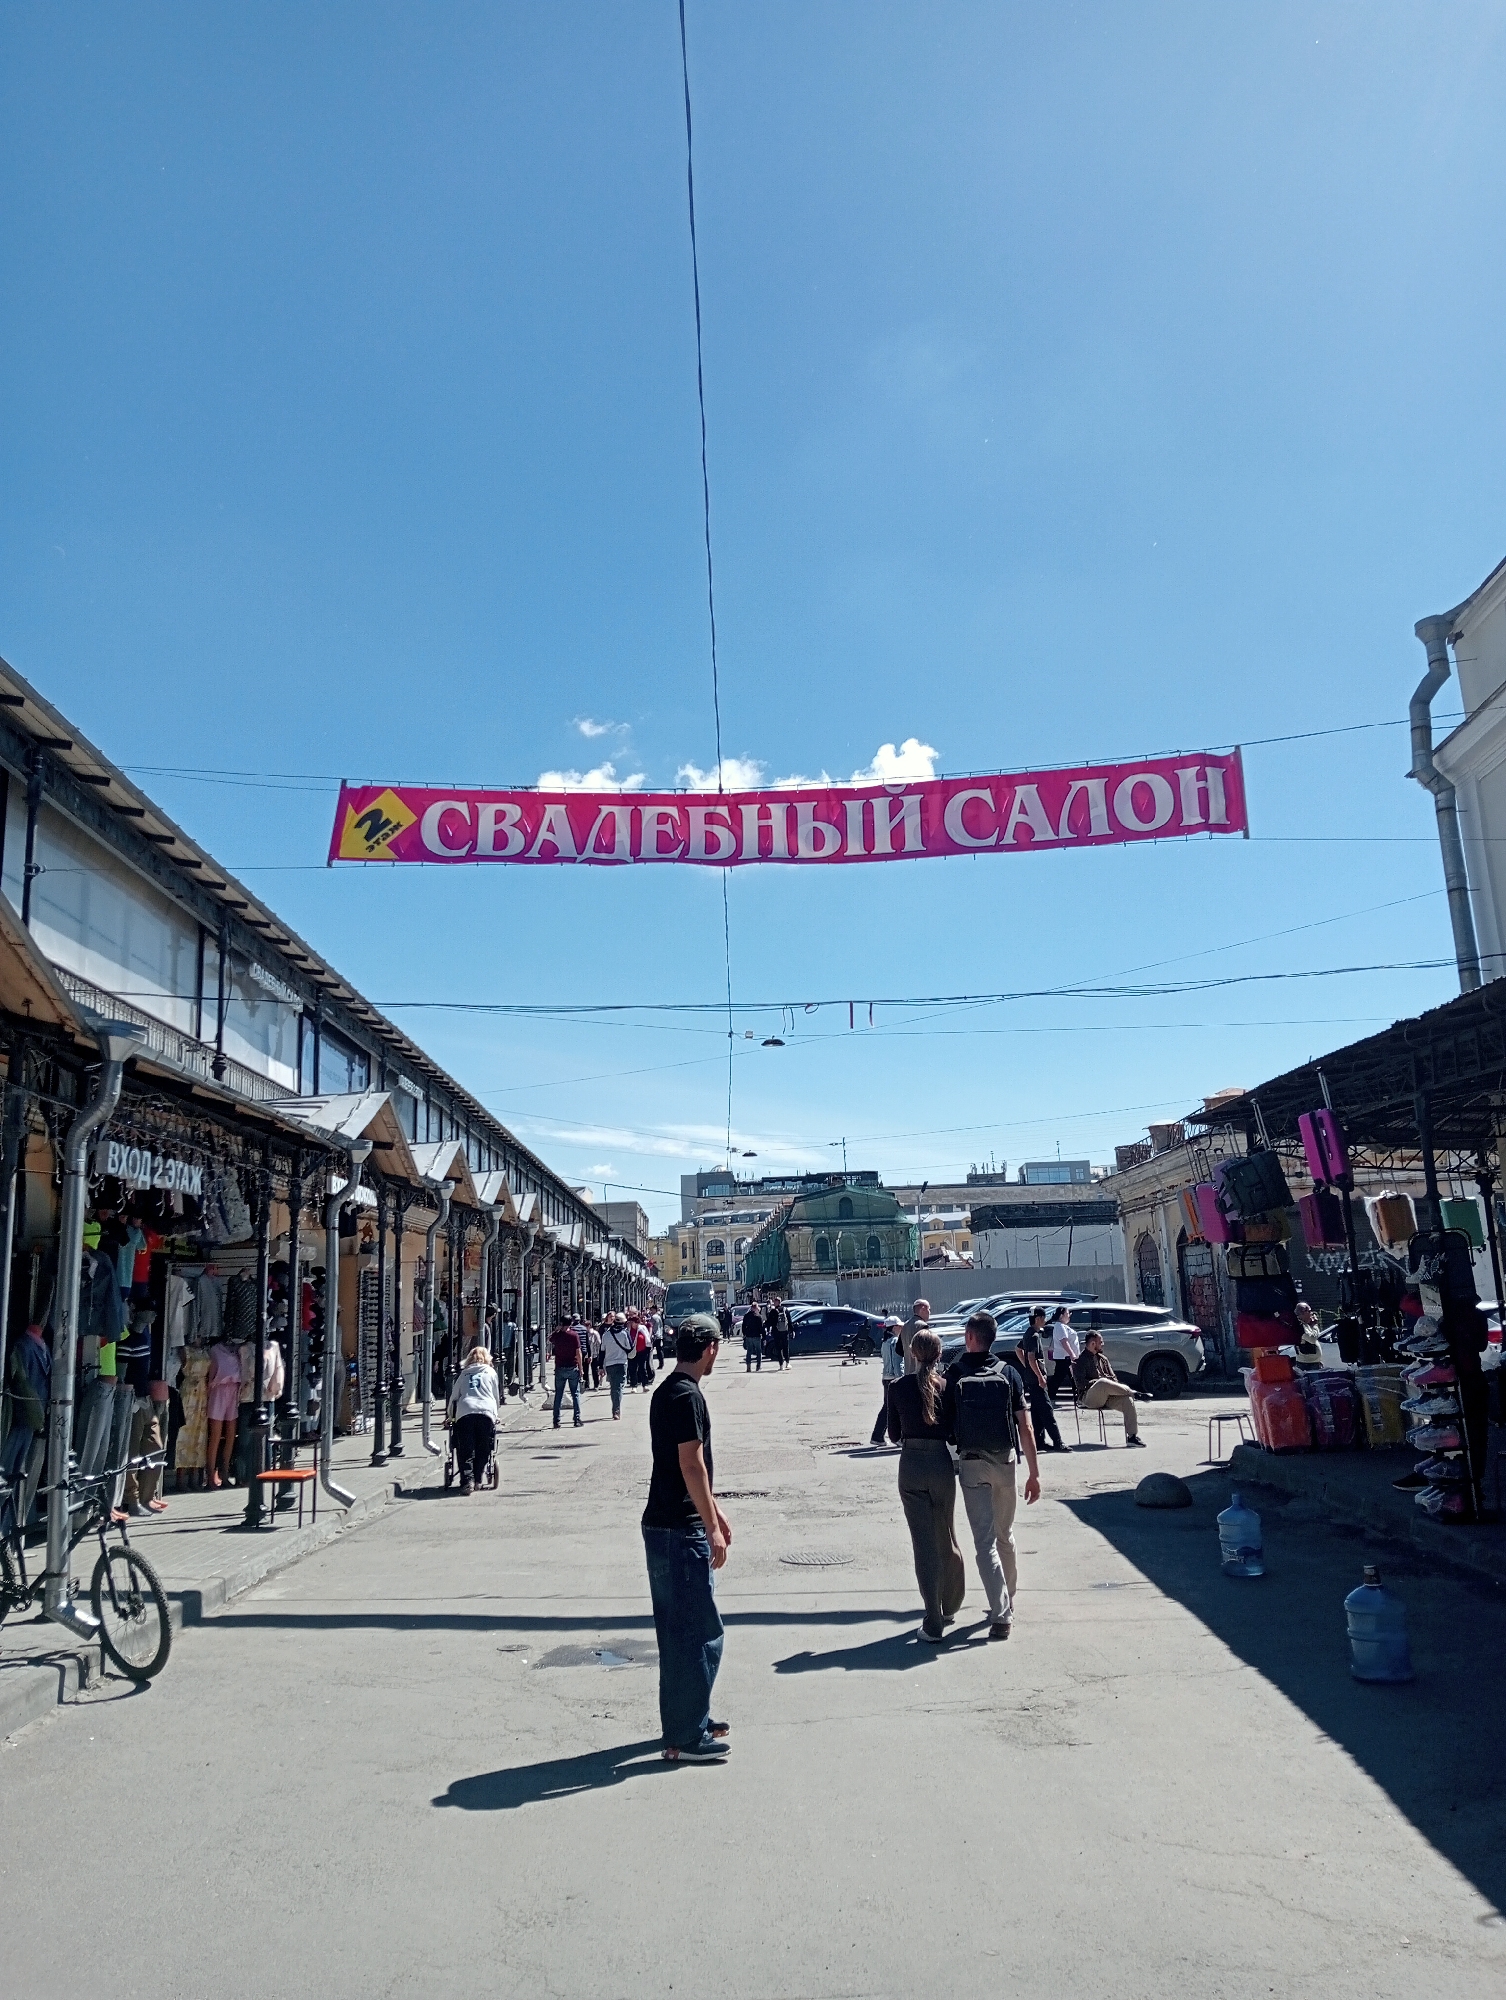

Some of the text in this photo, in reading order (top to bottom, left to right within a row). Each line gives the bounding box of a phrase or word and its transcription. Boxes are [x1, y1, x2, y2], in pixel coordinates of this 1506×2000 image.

[354, 808, 392, 842] 2
[420, 766, 1230, 863] СВАДЕБНЫЙ САЛОН
[365, 821, 403, 853] этаж
[107, 1141, 203, 1195] ВХОД 2 ЭТАЖ
